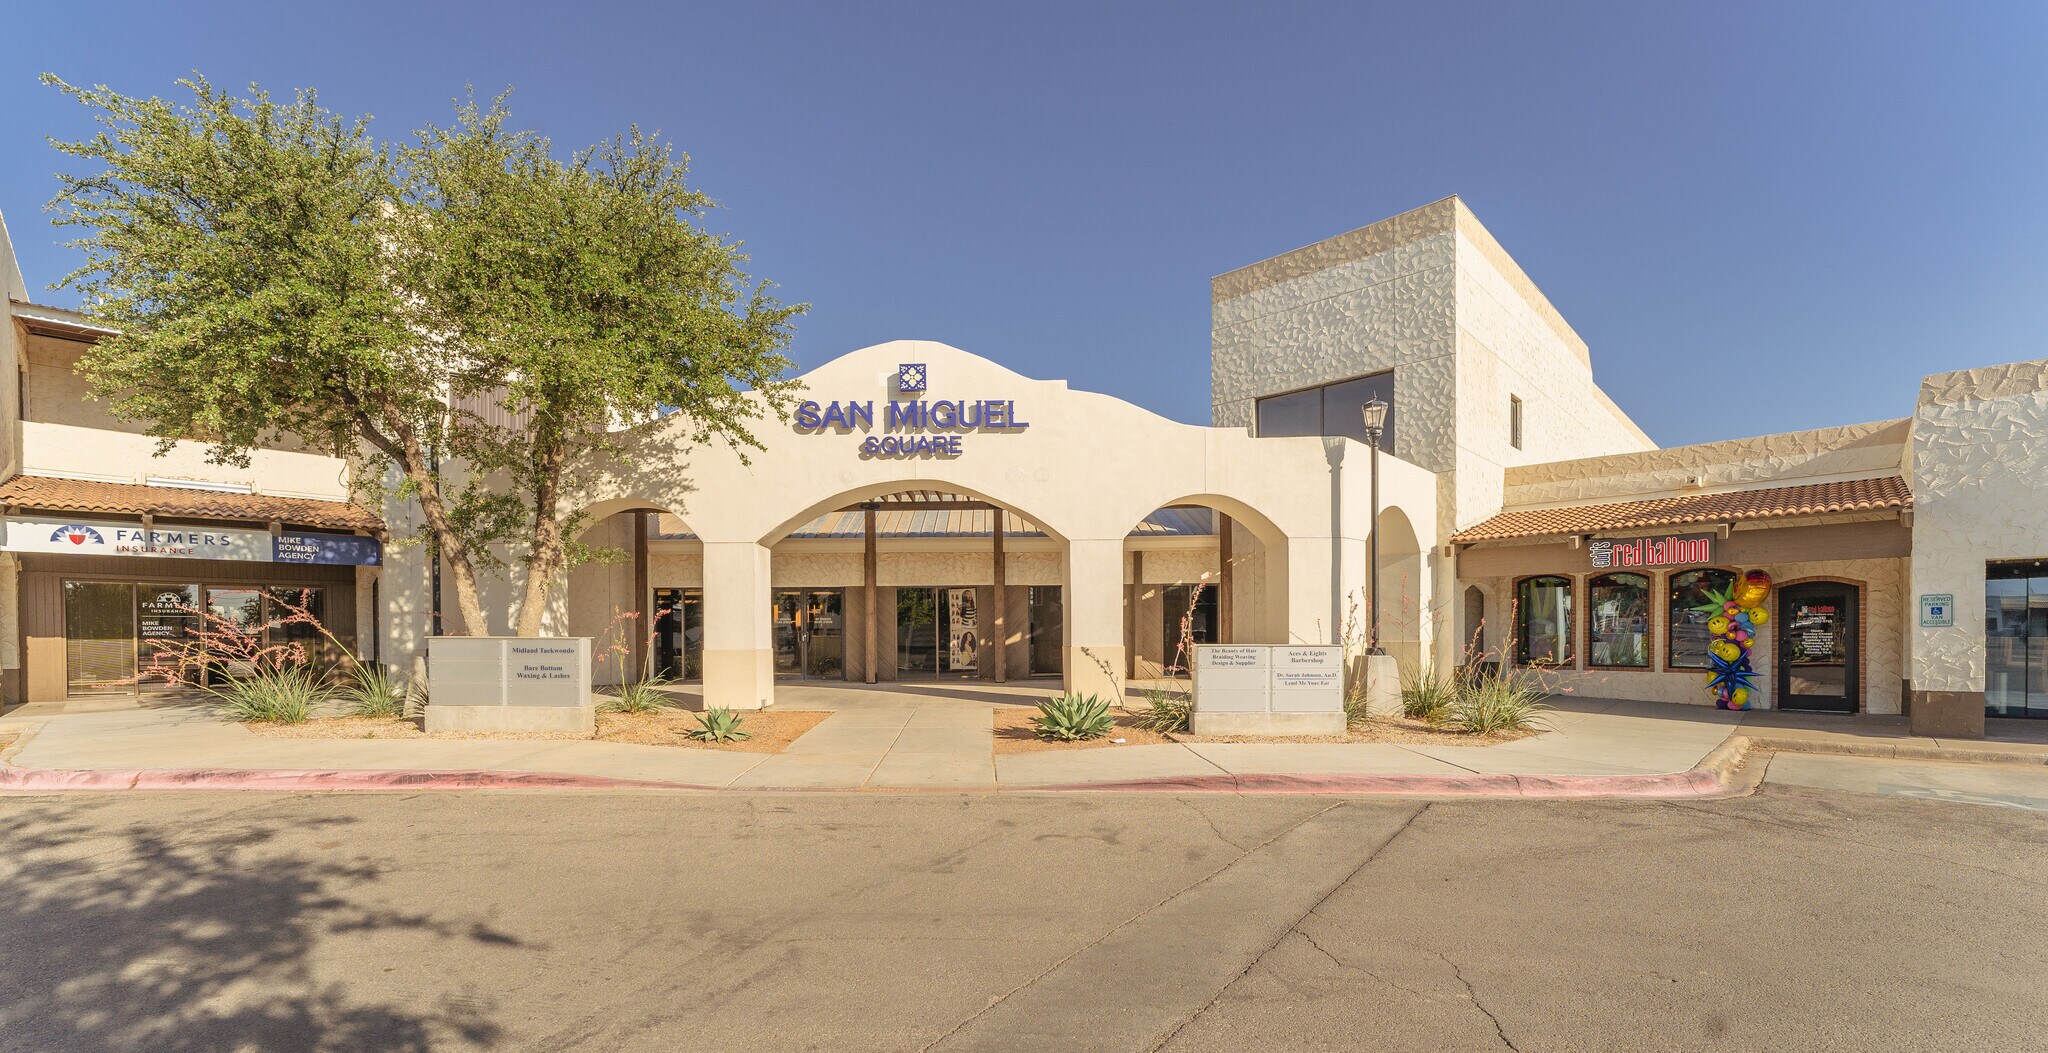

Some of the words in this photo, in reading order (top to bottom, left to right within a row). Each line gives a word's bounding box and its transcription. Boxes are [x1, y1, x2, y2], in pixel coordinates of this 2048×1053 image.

[798, 400, 874, 429] SAN
[890, 400, 1030, 428] MIGUEL
[864, 435, 963, 455] SQUARE
[116, 530, 231, 546] FARMERS
[278, 536, 302, 544] MIKE
[116, 545, 195, 555] INSURANCE
[278, 544, 320, 553] BOWDEN
[1612, 538, 1643, 567] red
[1645, 536, 1710, 566] balloon
[278, 552, 316, 560] AGENCY
[516, 672, 540, 680] Waxing
